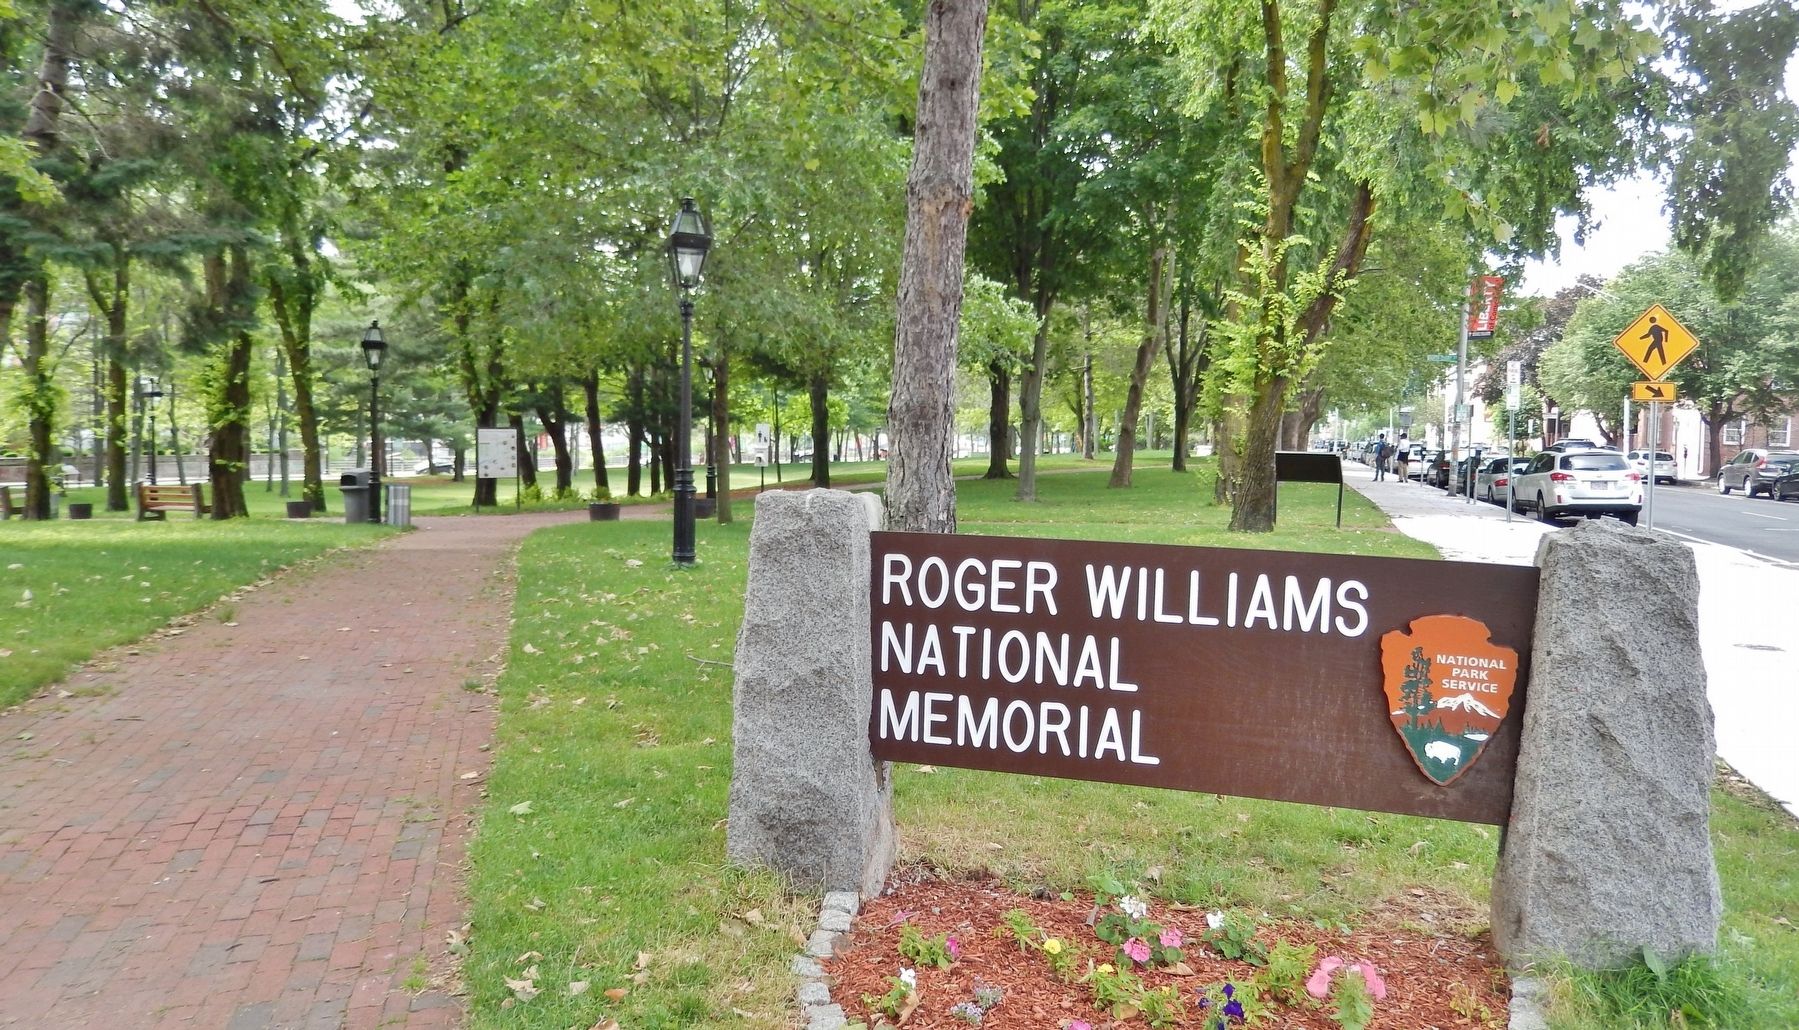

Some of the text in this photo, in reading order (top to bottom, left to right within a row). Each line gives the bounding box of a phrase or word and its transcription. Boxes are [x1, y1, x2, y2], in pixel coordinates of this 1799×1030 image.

[882, 553, 1369, 638] ROGER WILLIAMS
[880, 620, 1139, 692] NATIONAL
[1436, 654, 1507, 670] NATIONAL
[1452, 668, 1489, 681] PARK
[1441, 678, 1498, 693] SERVICE
[879, 688, 1161, 765] MEMORIAL
